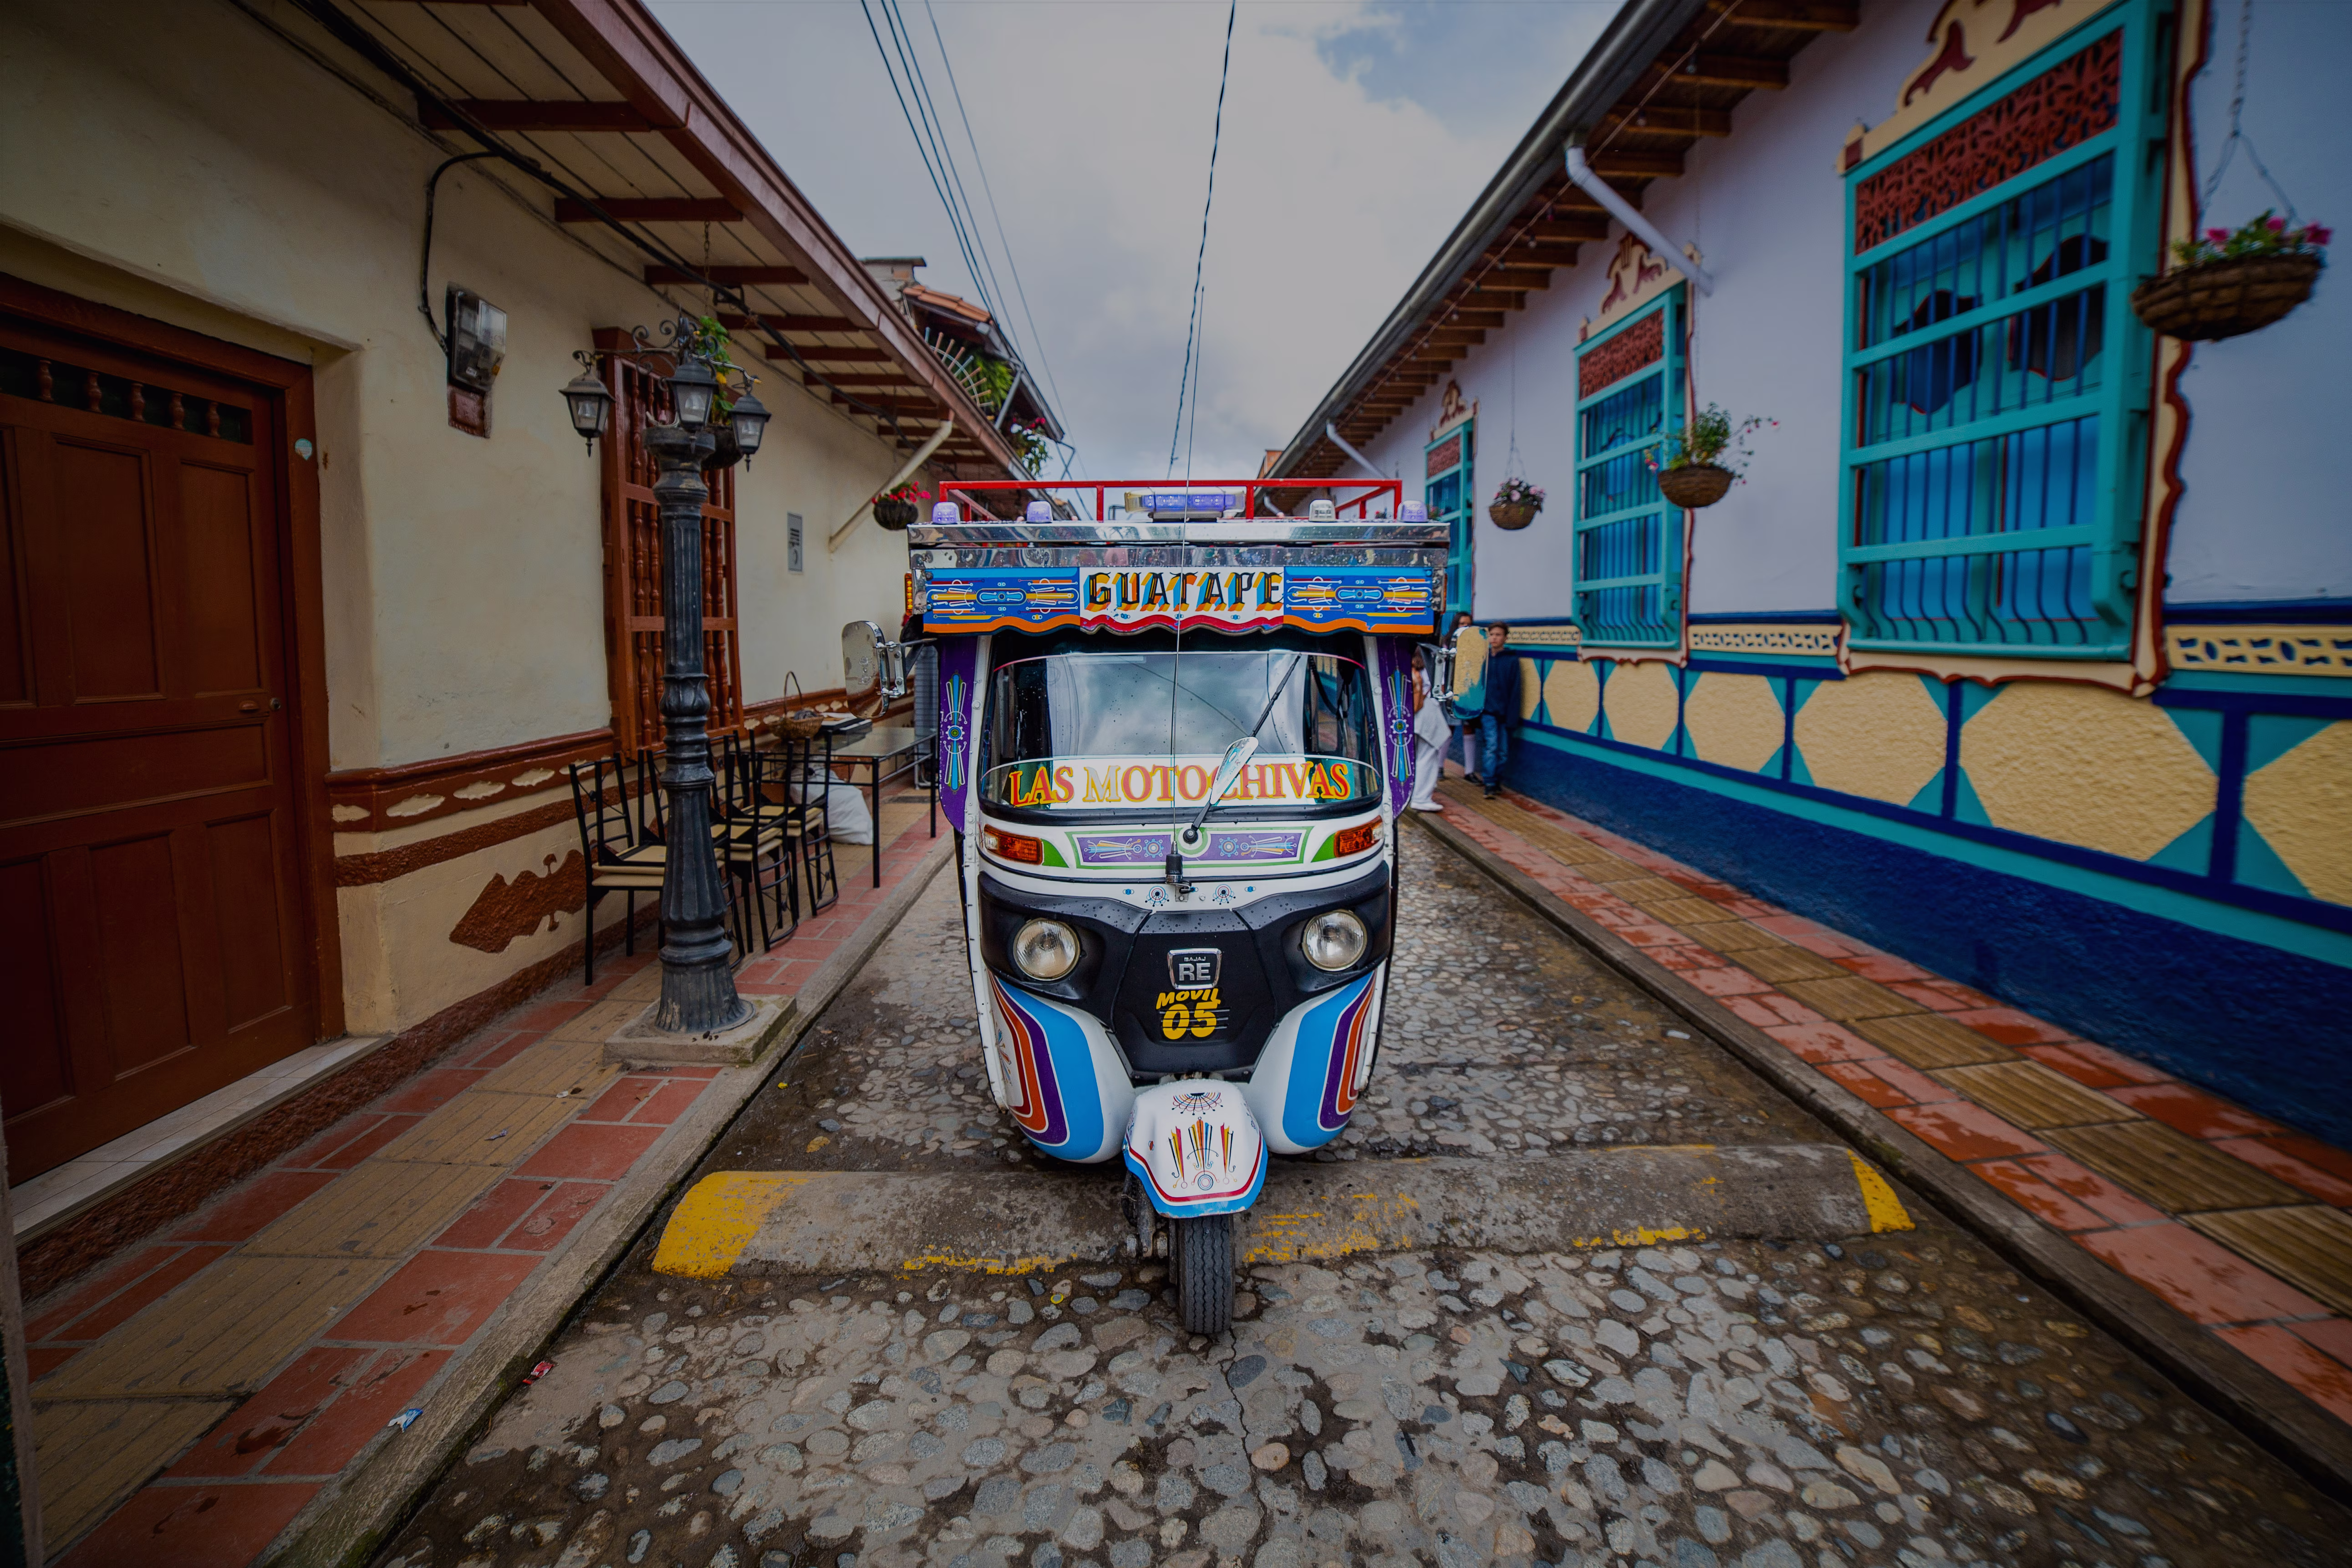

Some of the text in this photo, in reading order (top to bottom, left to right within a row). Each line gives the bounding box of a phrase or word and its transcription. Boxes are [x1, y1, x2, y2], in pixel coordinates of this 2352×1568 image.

[1084, 571, 1284, 611] GUATAPE
[1009, 766, 1075, 808] LAS
[1178, 962, 1211, 981] RE
[1156, 988, 1221, 1010] MOVIL
[1162, 1001, 1217, 1040] 05
